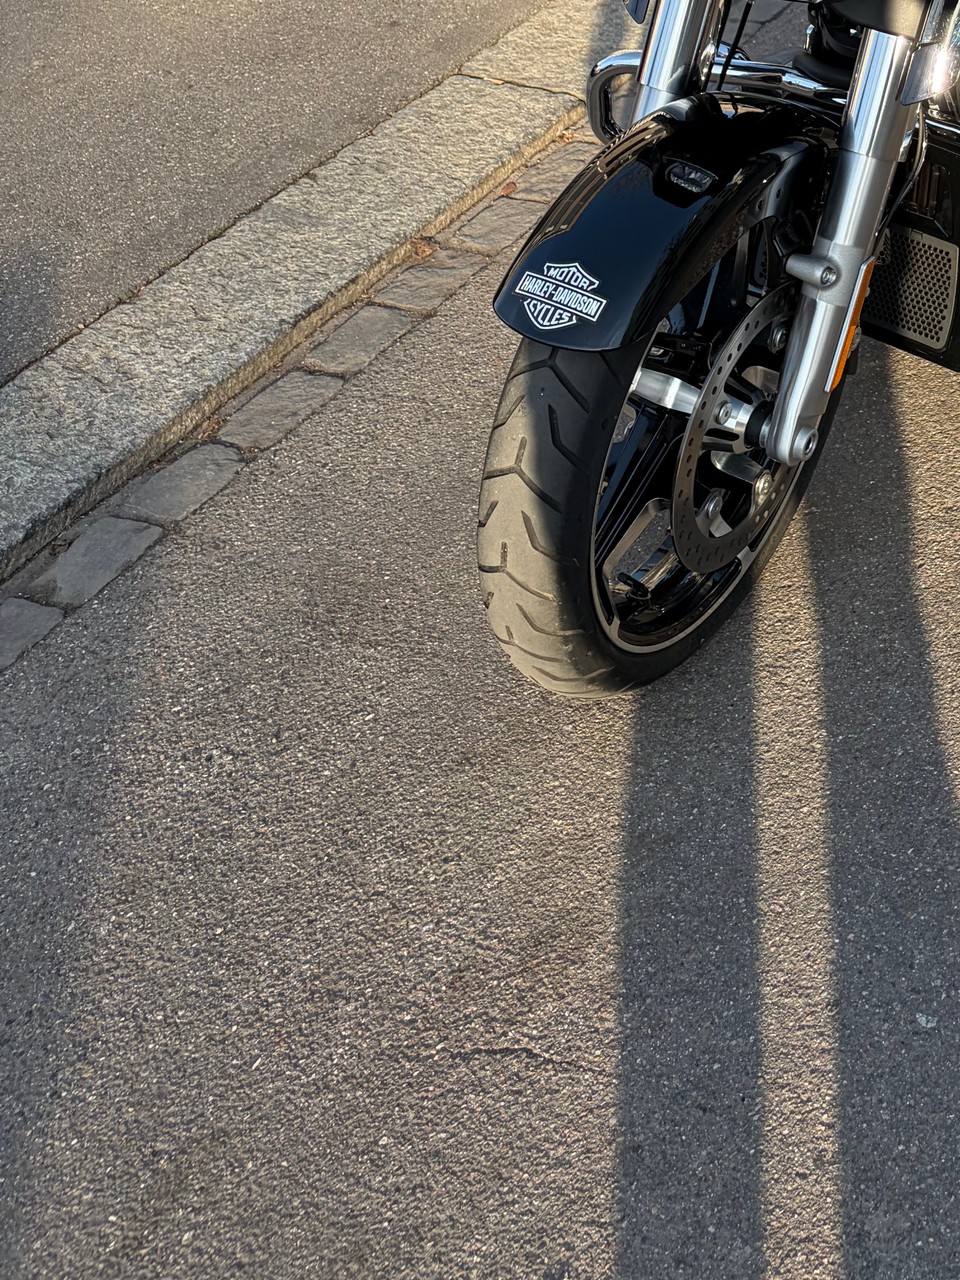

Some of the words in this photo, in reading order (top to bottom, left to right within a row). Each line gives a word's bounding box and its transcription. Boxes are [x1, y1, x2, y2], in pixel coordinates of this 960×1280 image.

[547, 266, 590, 290] MOTOR
[520, 276, 601, 317] HARLEY-DAVIDSON
[529, 300, 571, 326] CYCLES
